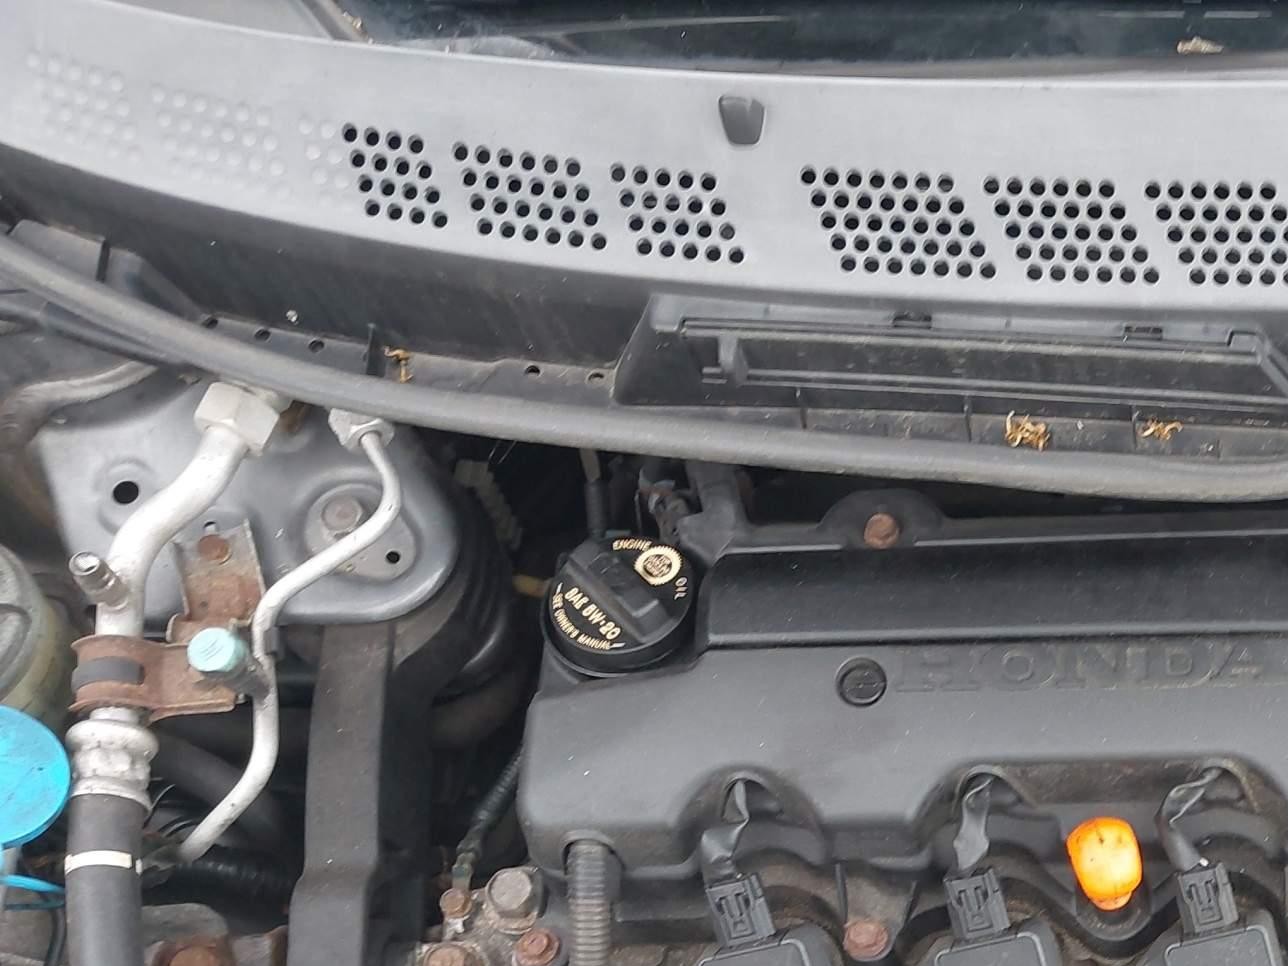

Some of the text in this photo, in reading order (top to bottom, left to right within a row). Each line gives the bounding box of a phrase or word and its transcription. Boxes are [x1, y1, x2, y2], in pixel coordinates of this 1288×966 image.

[612, 539, 652, 551] ENGINE
[564, 587, 590, 610] SAE
[674, 577, 688, 600] OIL
[576, 633, 611, 650] MANUAL
